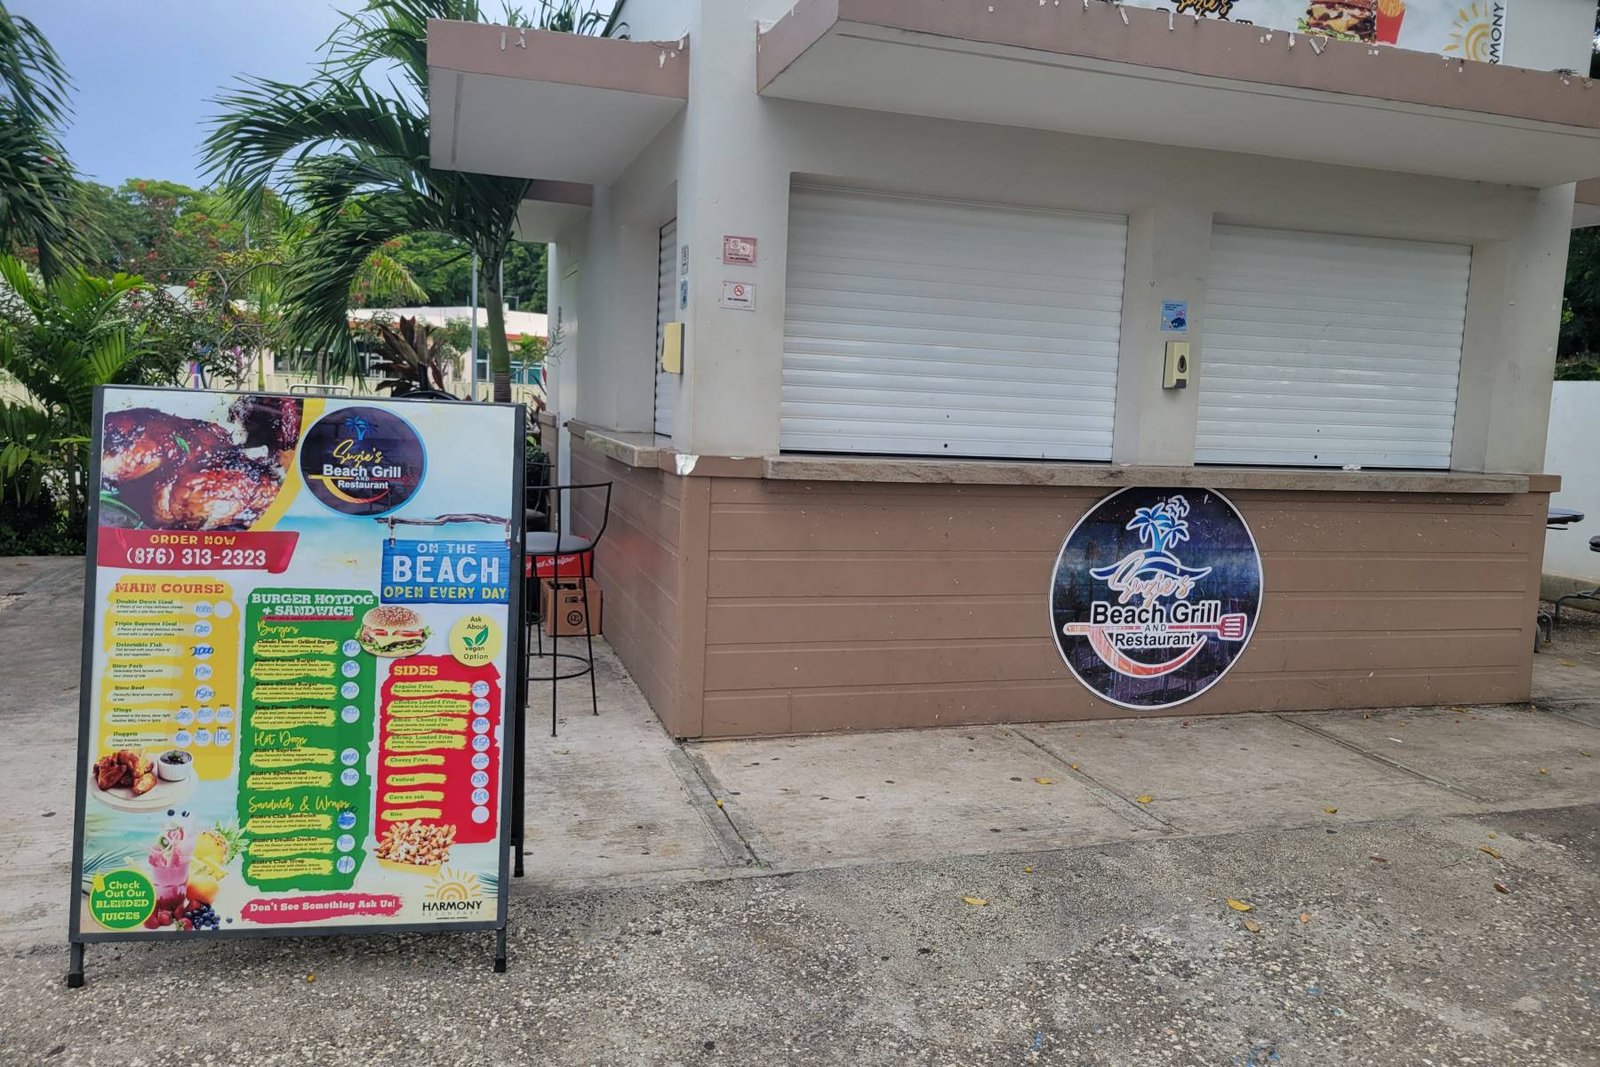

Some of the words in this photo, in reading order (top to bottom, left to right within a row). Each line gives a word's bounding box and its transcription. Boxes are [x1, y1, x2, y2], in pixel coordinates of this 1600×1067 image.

[1489, 2, 1504, 64] RMONY
[333, 439, 383, 468] Suzie's
[323, 464, 367, 477] Beach
[371, 465, 401, 478] Grill
[337, 480, 389, 489] Restaurant
[150, 534, 198, 545] ORDER
[204, 535, 236, 545] NOW
[417, 543, 438, 553] ON
[447, 543, 477, 554] THE
[126, 547, 175, 565] (876)
[181, 549, 267, 566] 313-2323
[392, 555, 500, 583] BEACH
[115, 583, 157, 593] MAIN
[161, 583, 225, 594] COURSE
[383, 586, 423, 598] OPEN
[429, 586, 475, 599] EVERY
[482, 587, 507, 599] DAY
[251, 594, 311, 604] BURGER
[315, 594, 375, 605] HOTDOG
[275, 605, 354, 616] SANDWICH
[1092, 602, 1165, 625] Beach
[1172, 602, 1219, 624] Grill
[257, 619, 299, 638] Burgers
[1145, 624, 1167, 632] AND
[1115, 633, 1196, 647] Restaurant
[394, 665, 438, 676] SIDES
[254, 731, 276, 746] Hot
[280, 731, 308, 747] Dogs
[249, 796, 294, 813] Sandwich
[300, 795, 310, 812] &
[316, 795, 351, 812] Wraps
[109, 881, 140, 889] Check
[105, 889, 124, 898] Out
[126, 889, 146, 897] Our
[96, 899, 149, 908] BLENDED
[250, 902, 278, 912] Don't
[280, 903, 299, 912] See
[302, 900, 355, 911] Something
[358, 900, 377, 909] Ask
[380, 899, 396, 908] Us!
[422, 900, 482, 911] HARMONY
[102, 912, 141, 922] JUICES
